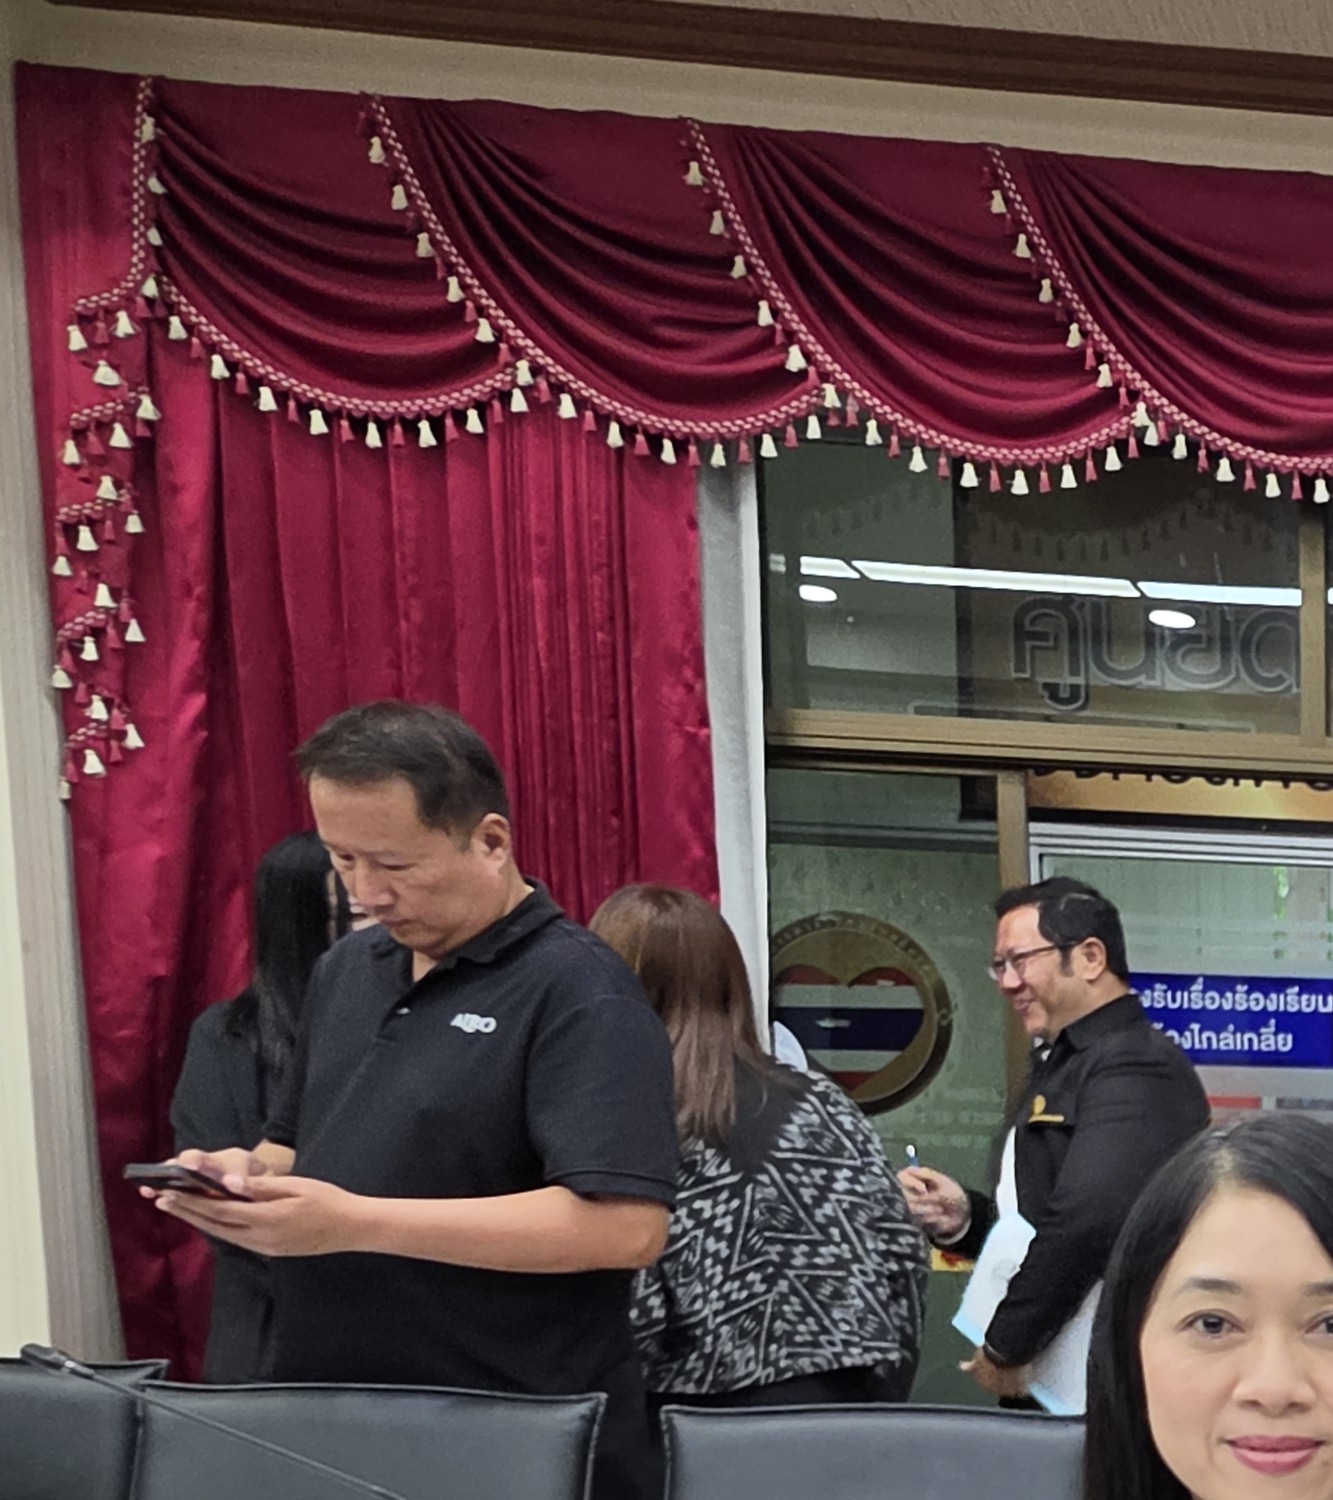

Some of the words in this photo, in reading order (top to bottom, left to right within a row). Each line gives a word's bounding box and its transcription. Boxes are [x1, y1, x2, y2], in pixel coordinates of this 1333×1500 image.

[1130, 976, 1333, 1013] งรับเรื่องร้องเรียน
[1151, 1018, 1293, 1052] ้งไกล่เกลี่ย
